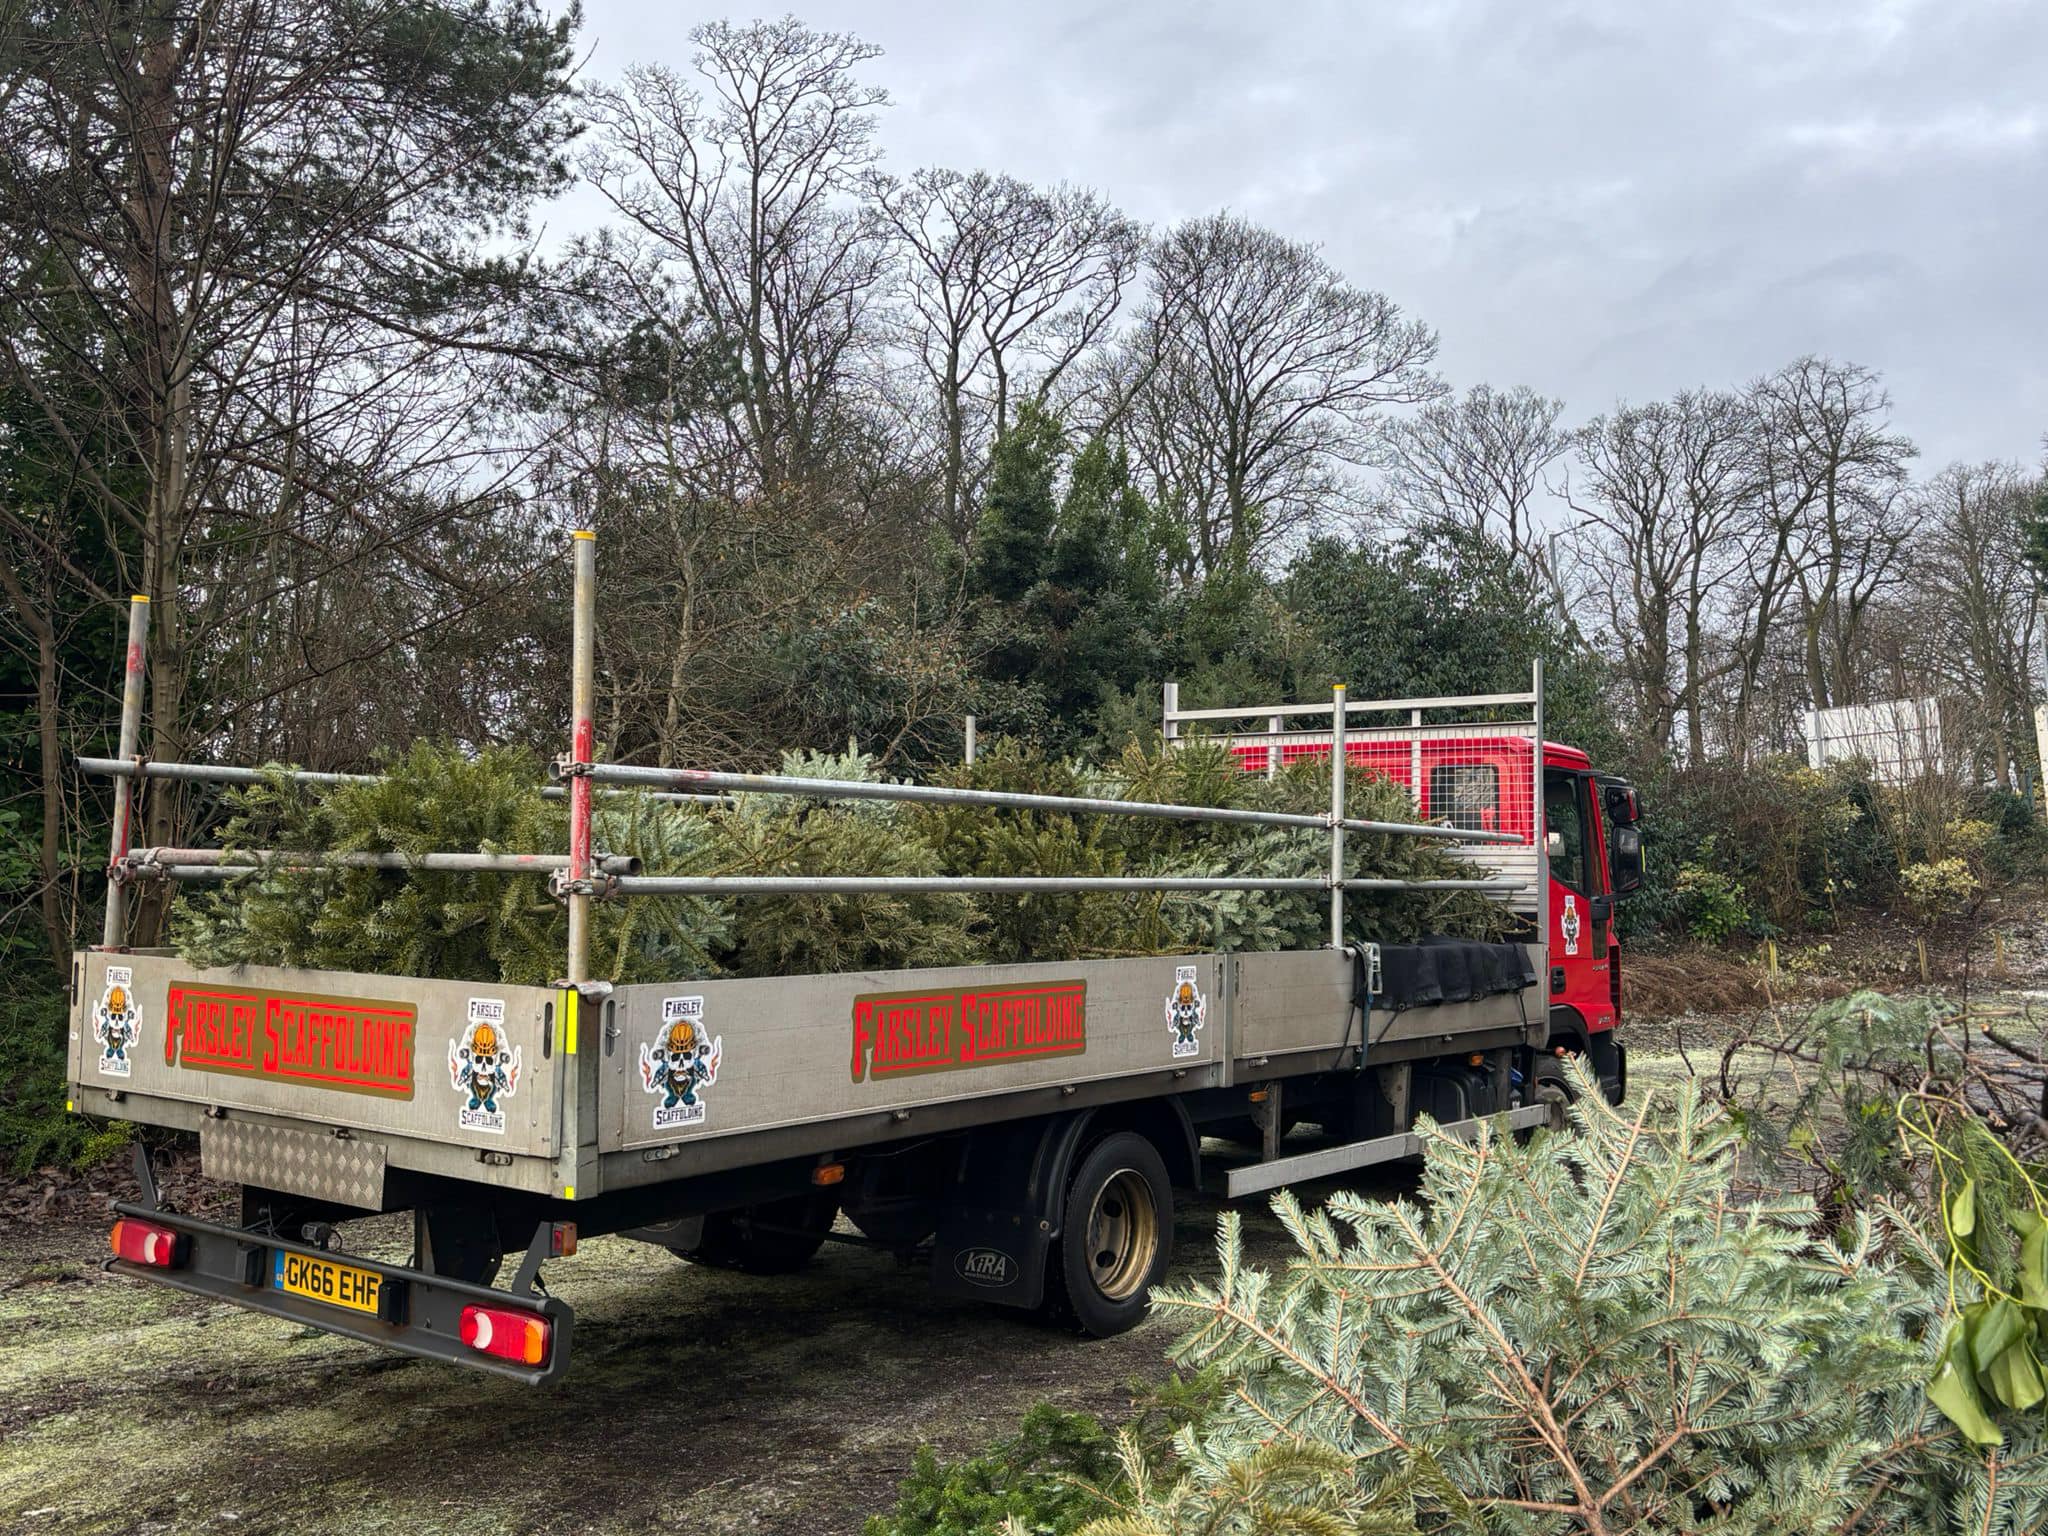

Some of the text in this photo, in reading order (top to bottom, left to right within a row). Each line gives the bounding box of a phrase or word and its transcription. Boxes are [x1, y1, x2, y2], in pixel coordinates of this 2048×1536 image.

[471, 1001, 502, 1018] FARSLEY
[665, 1000, 702, 1017] FARSLEY
[167, 988, 412, 1080] FARSLEY SCAFFOLDING
[854, 993, 1083, 1076] FARSLEY SCAFFOLDING
[462, 1110, 503, 1128] SCAFFOLDING
[656, 1105, 704, 1125] SCAFFOLDING
[288, 1257, 378, 1305] GK66 EHF
